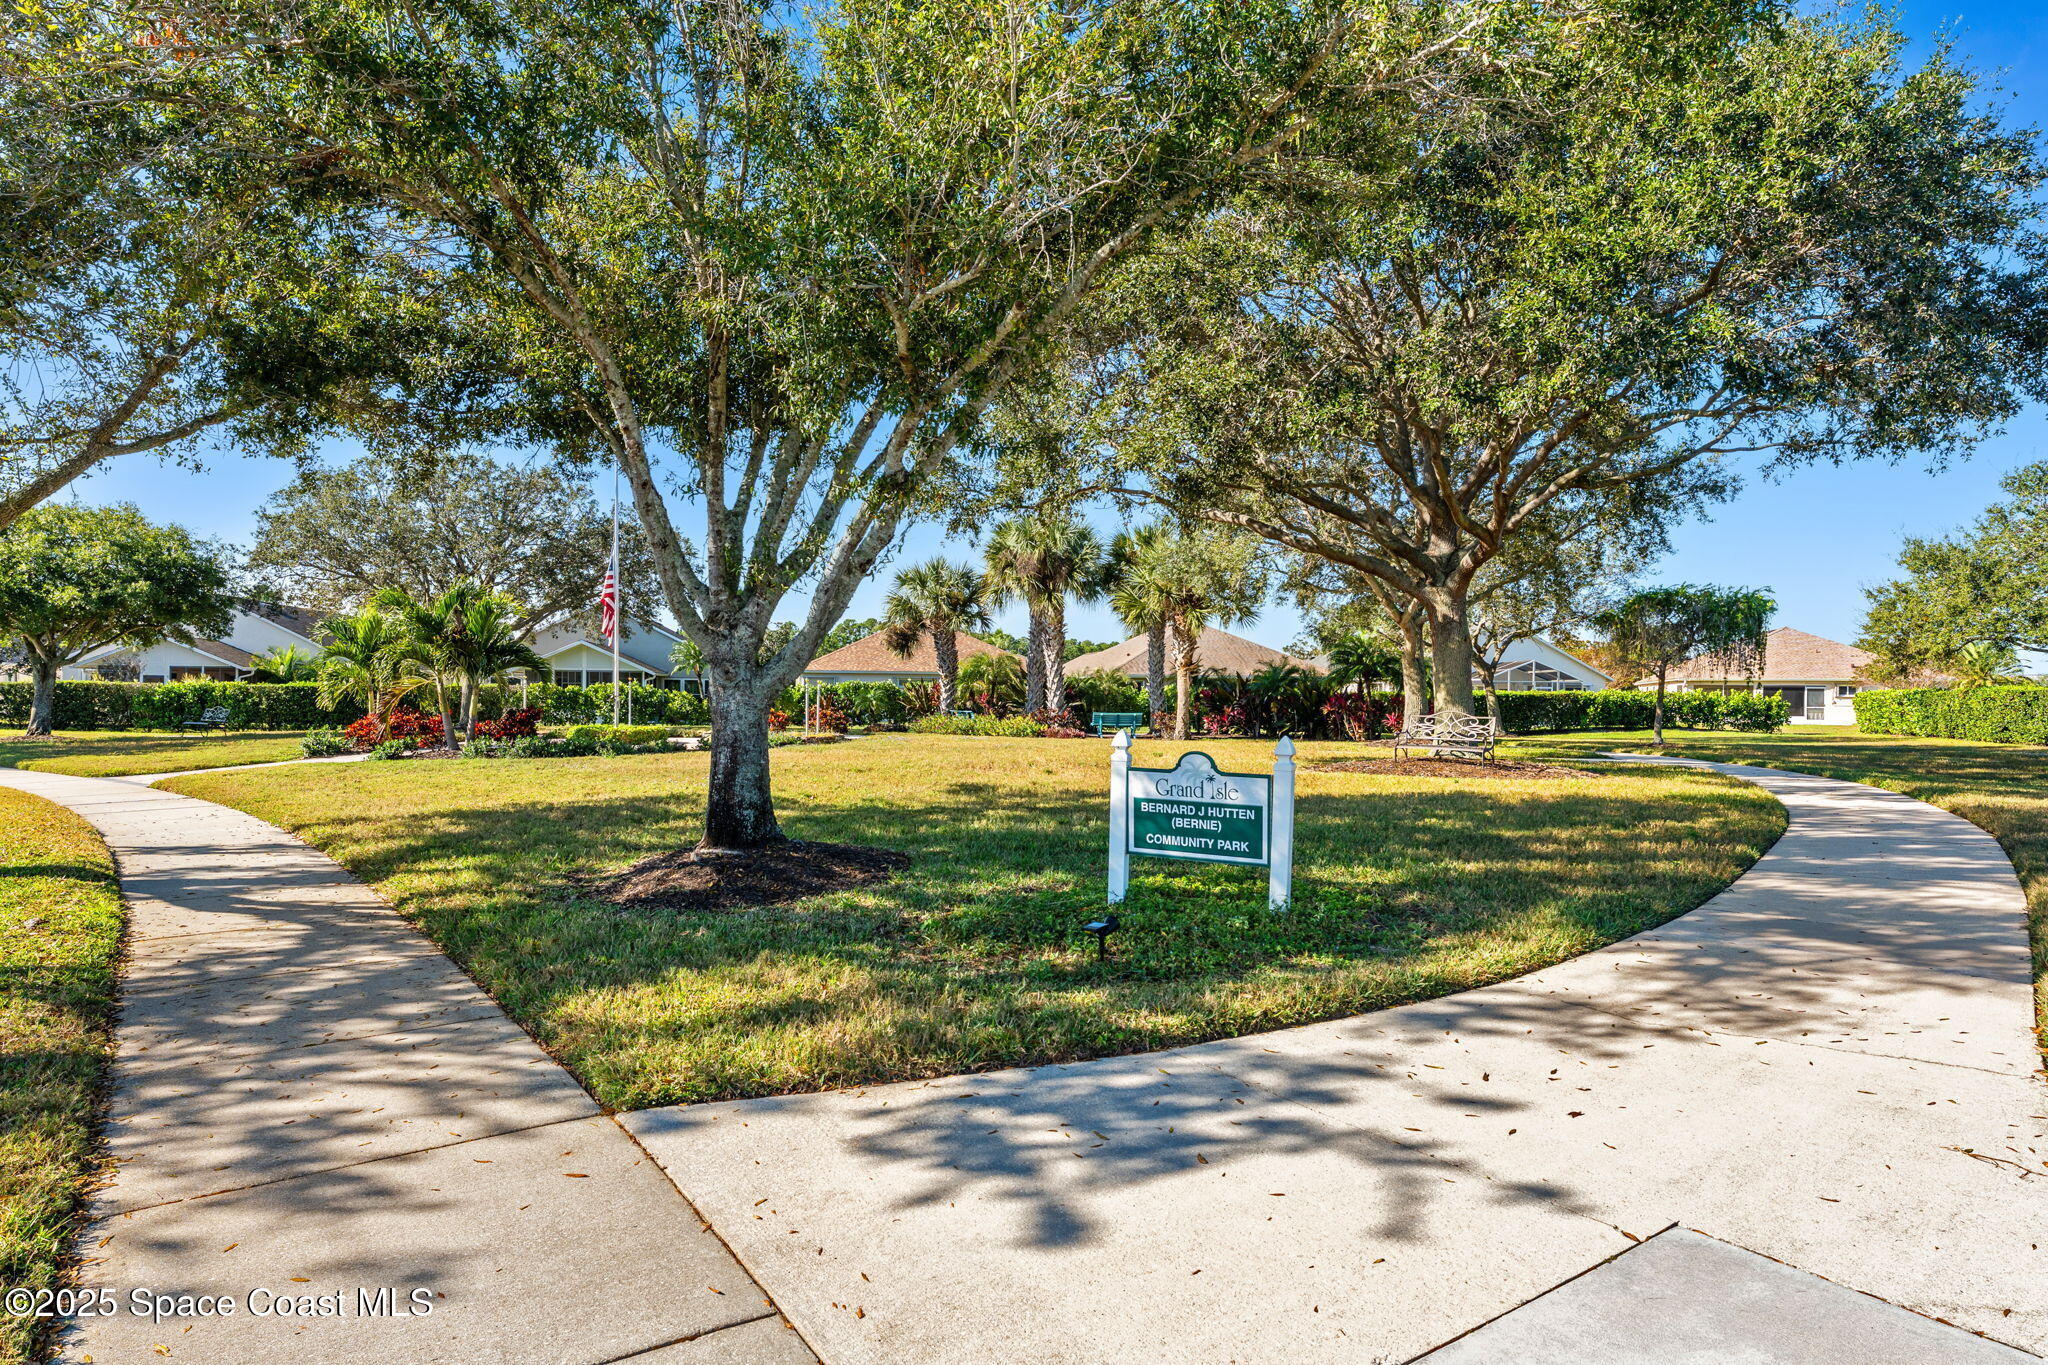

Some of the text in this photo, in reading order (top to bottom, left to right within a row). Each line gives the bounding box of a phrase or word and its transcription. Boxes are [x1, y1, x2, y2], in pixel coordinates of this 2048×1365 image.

[1155, 775, 1239, 801] Grand Isle
[1141, 802, 1255, 820] BERNARD J HUTTEN
[1171, 817, 1222, 833] (BERNIE)
[1146, 833, 1249, 852] COMMUNITY PARK
